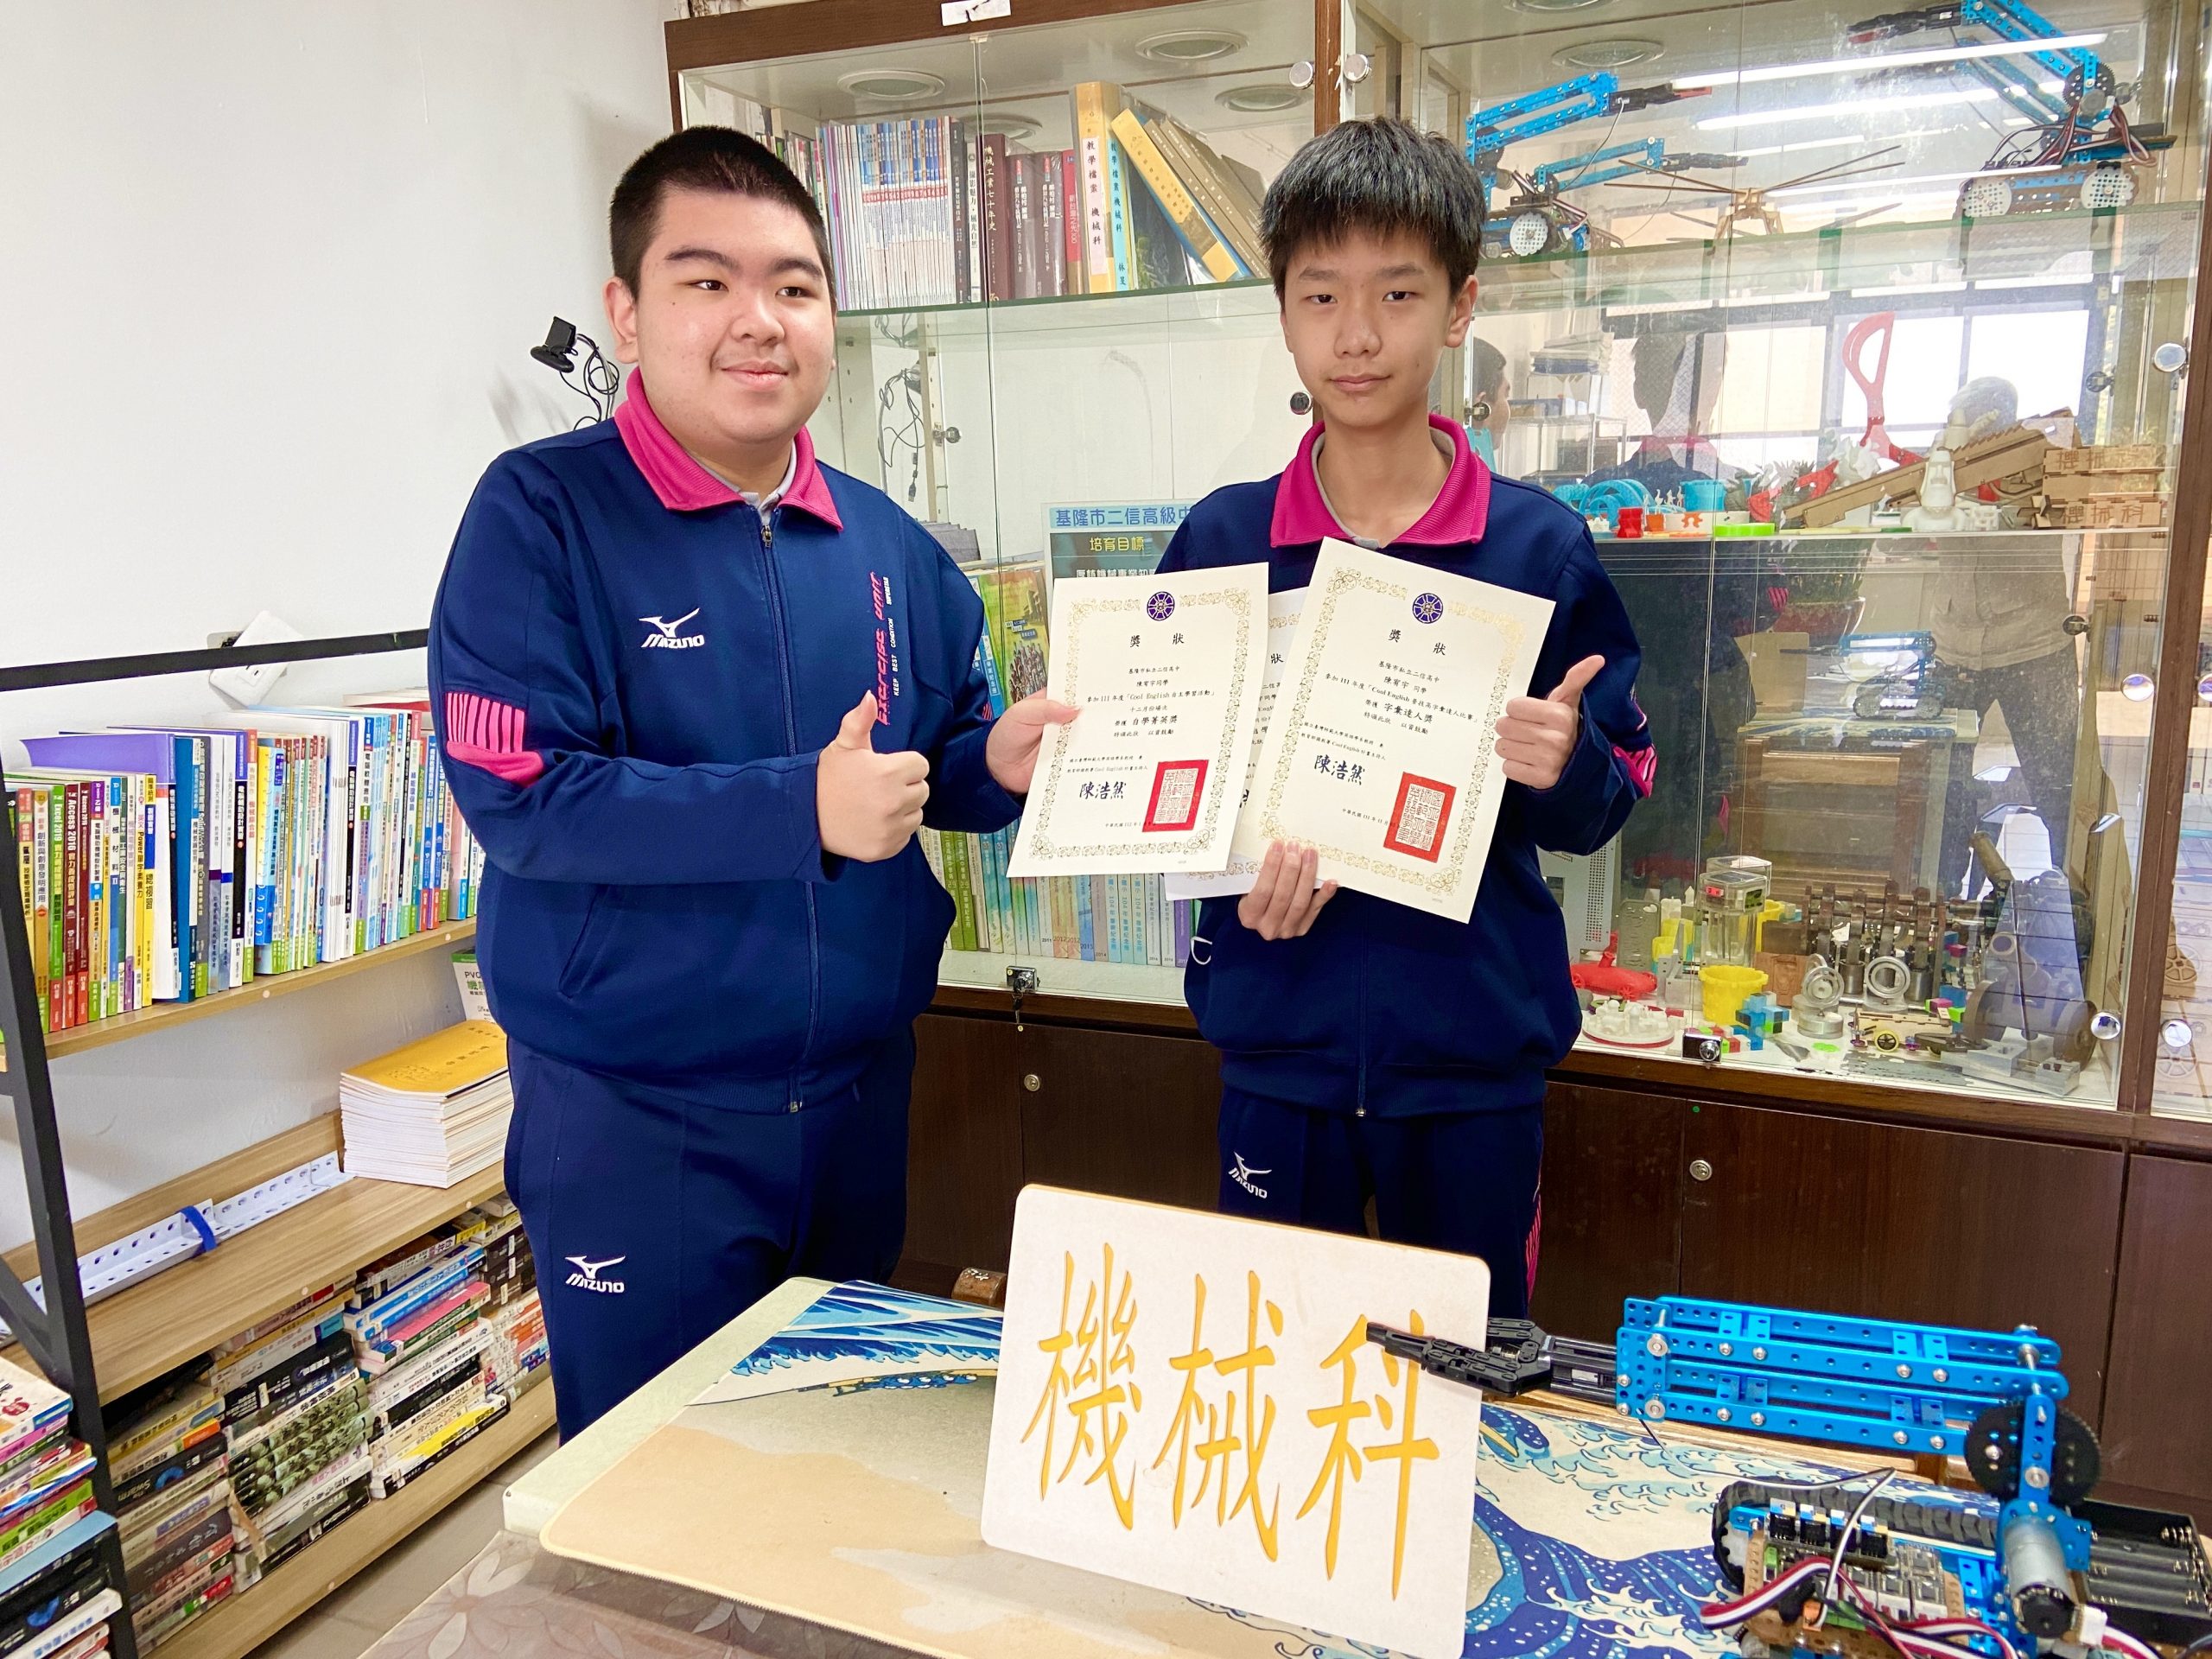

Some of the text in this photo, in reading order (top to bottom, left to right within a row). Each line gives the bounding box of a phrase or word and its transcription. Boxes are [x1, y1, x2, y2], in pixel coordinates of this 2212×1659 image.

[1091, 207, 1102, 245] 機械科
[2062, 504, 2144, 524] 機械科
[1090, 536, 1145, 552] 培育目標
[640, 633, 705, 649] MIZUNO
[1378, 660, 1440, 683] 基隆市私立二信高中
[1146, 691, 1170, 702] English
[1387, 690, 1410, 702] English
[1383, 702, 1433, 723] 字彙達人獎
[1313, 753, 1366, 786] 陳浩然
[1079, 781, 1127, 800] 陳浩然
[54, 803, 64, 827] Excel
[67, 799, 77, 834] Access
[54, 827, 63, 842] 2019
[67, 834, 77, 851] 2016
[1228, 1166, 1268, 1199] MIZUNO
[565, 1273, 625, 1294] MIZUNO
[1020, 1243, 1440, 1601] 機械科
